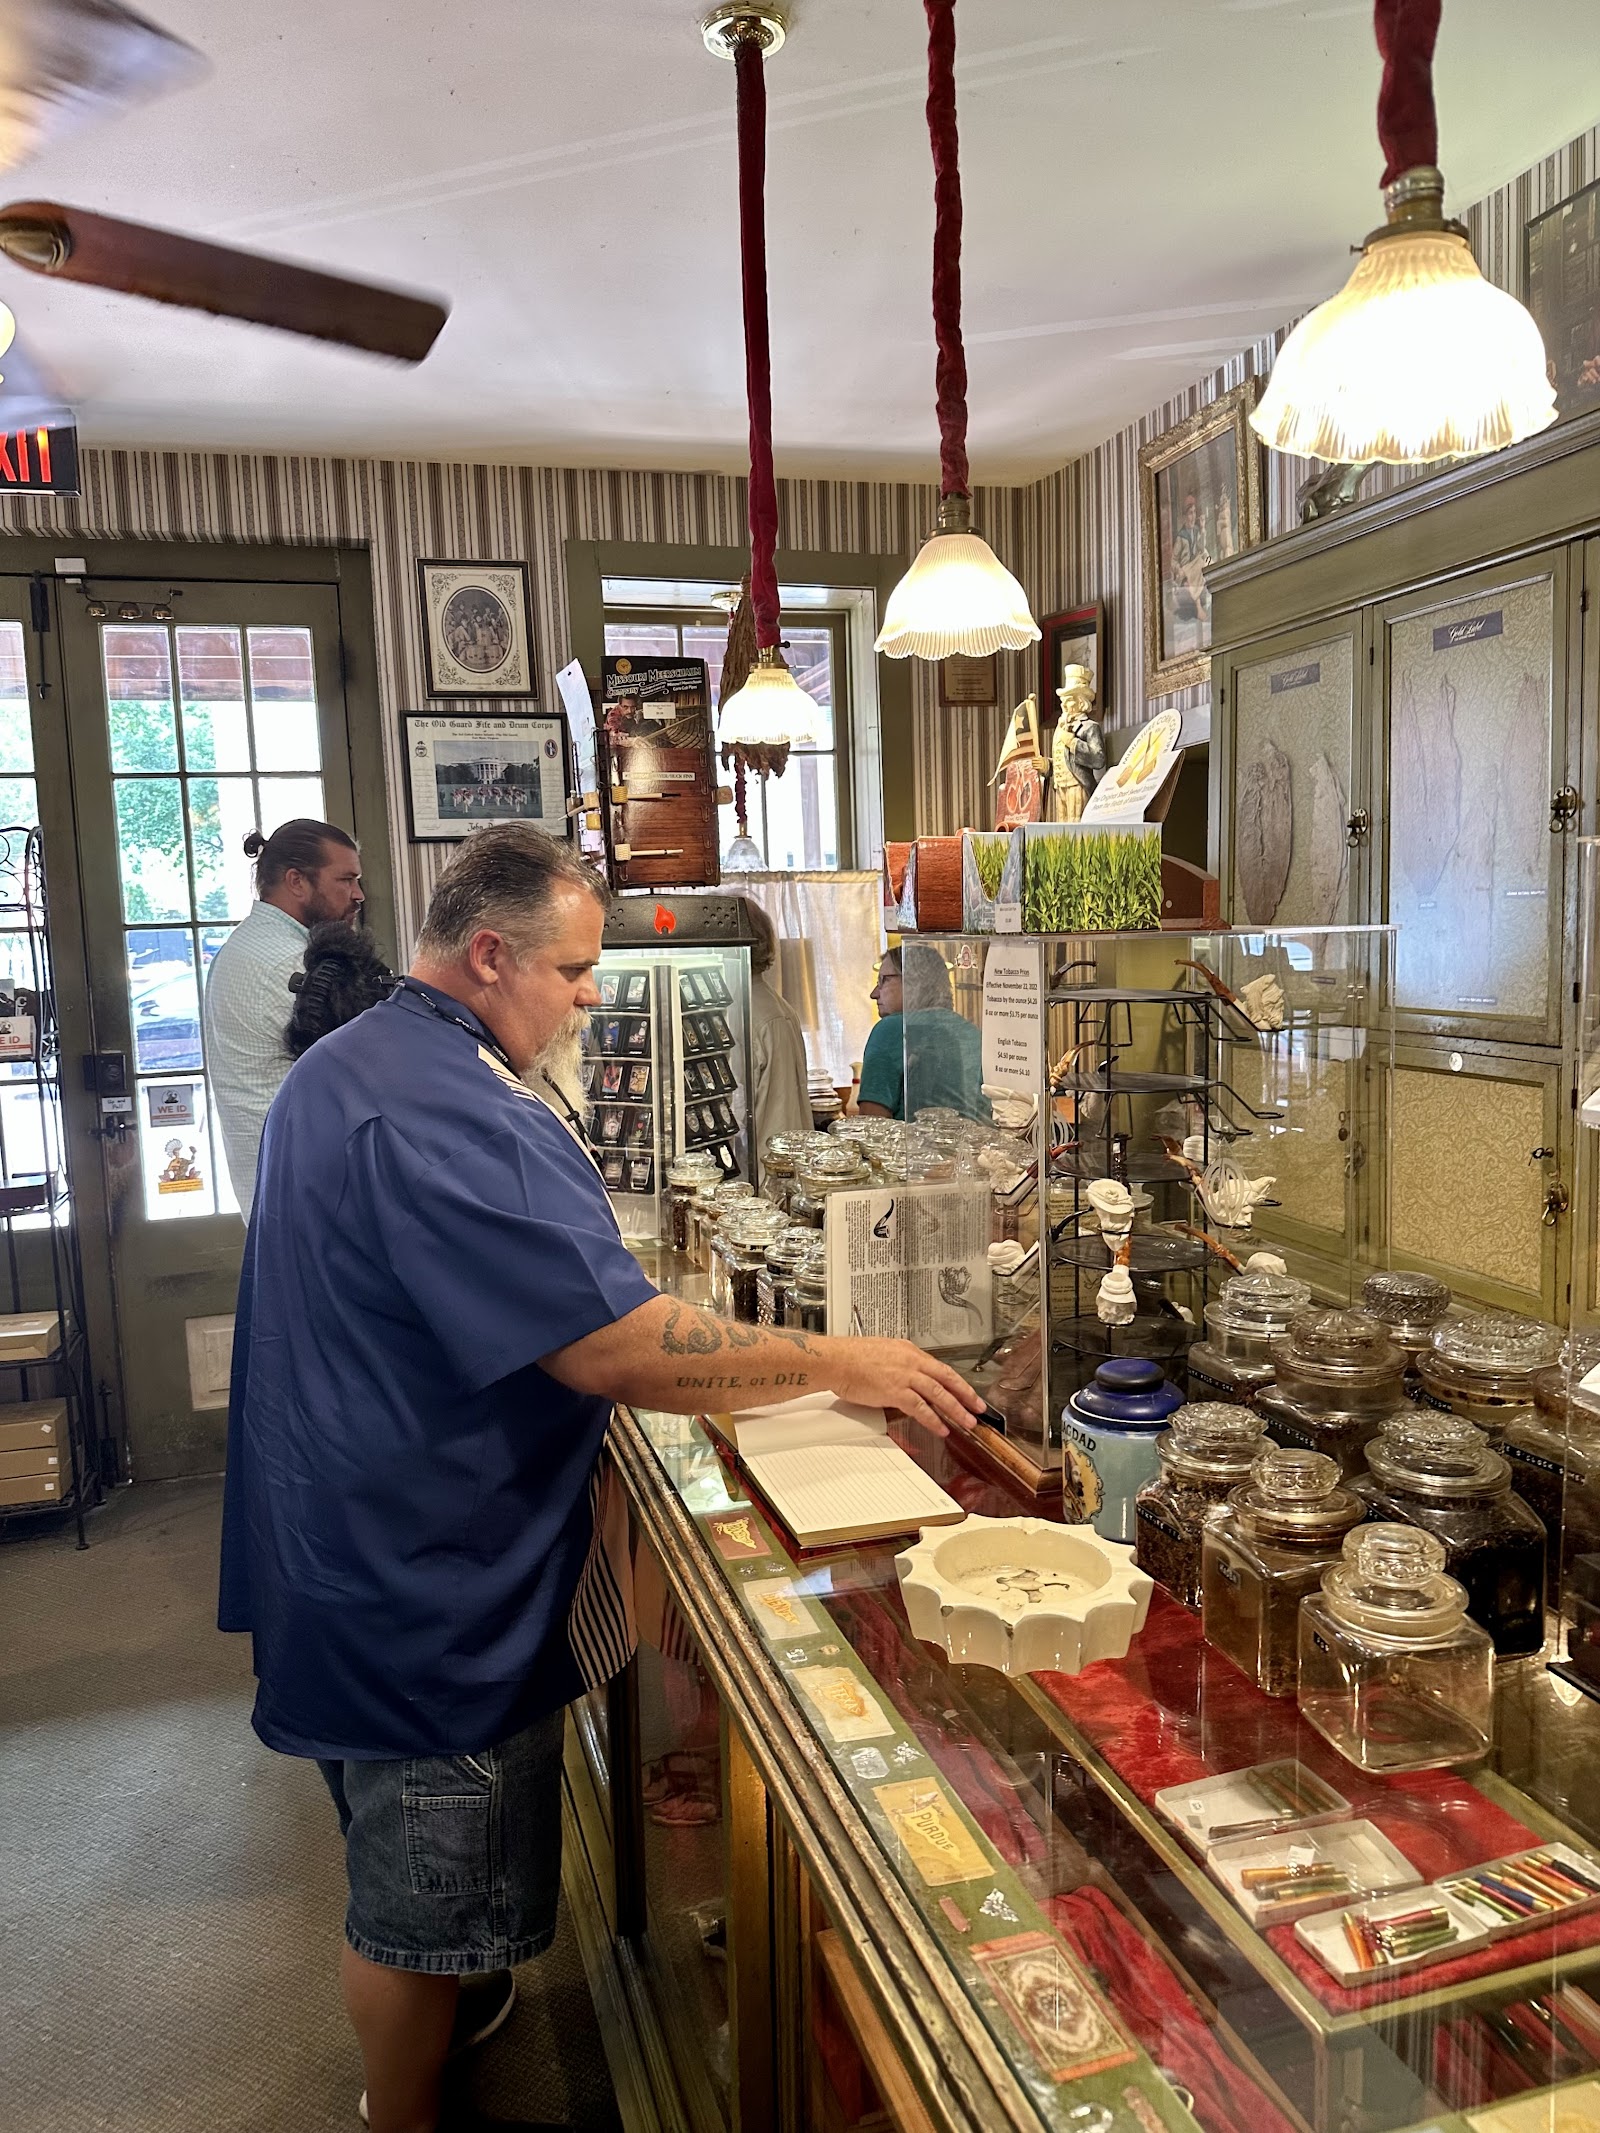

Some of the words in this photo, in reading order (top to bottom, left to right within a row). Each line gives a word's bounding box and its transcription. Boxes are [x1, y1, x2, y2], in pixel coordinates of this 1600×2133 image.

[0, 423, 56, 482] XIT
[606, 686, 640, 699] Company
[414, 719, 429, 728] The
[431, 719, 447, 728] Old
[449, 719, 473, 729] Guard
[475, 720, 491, 729] Fife
[493, 720, 506, 729] and
[508, 720, 529, 729] Drum
[531, 721, 554, 730] Corps
[9, 1036, 21, 1044] ID
[157, 1106, 174, 1114] WE
[176, 1105, 187, 1113] ID
[749, 1377, 767, 1386] or
[1062, 1421, 1097, 1452] AGDAD
[911, 1812, 954, 1850] PURDUE
